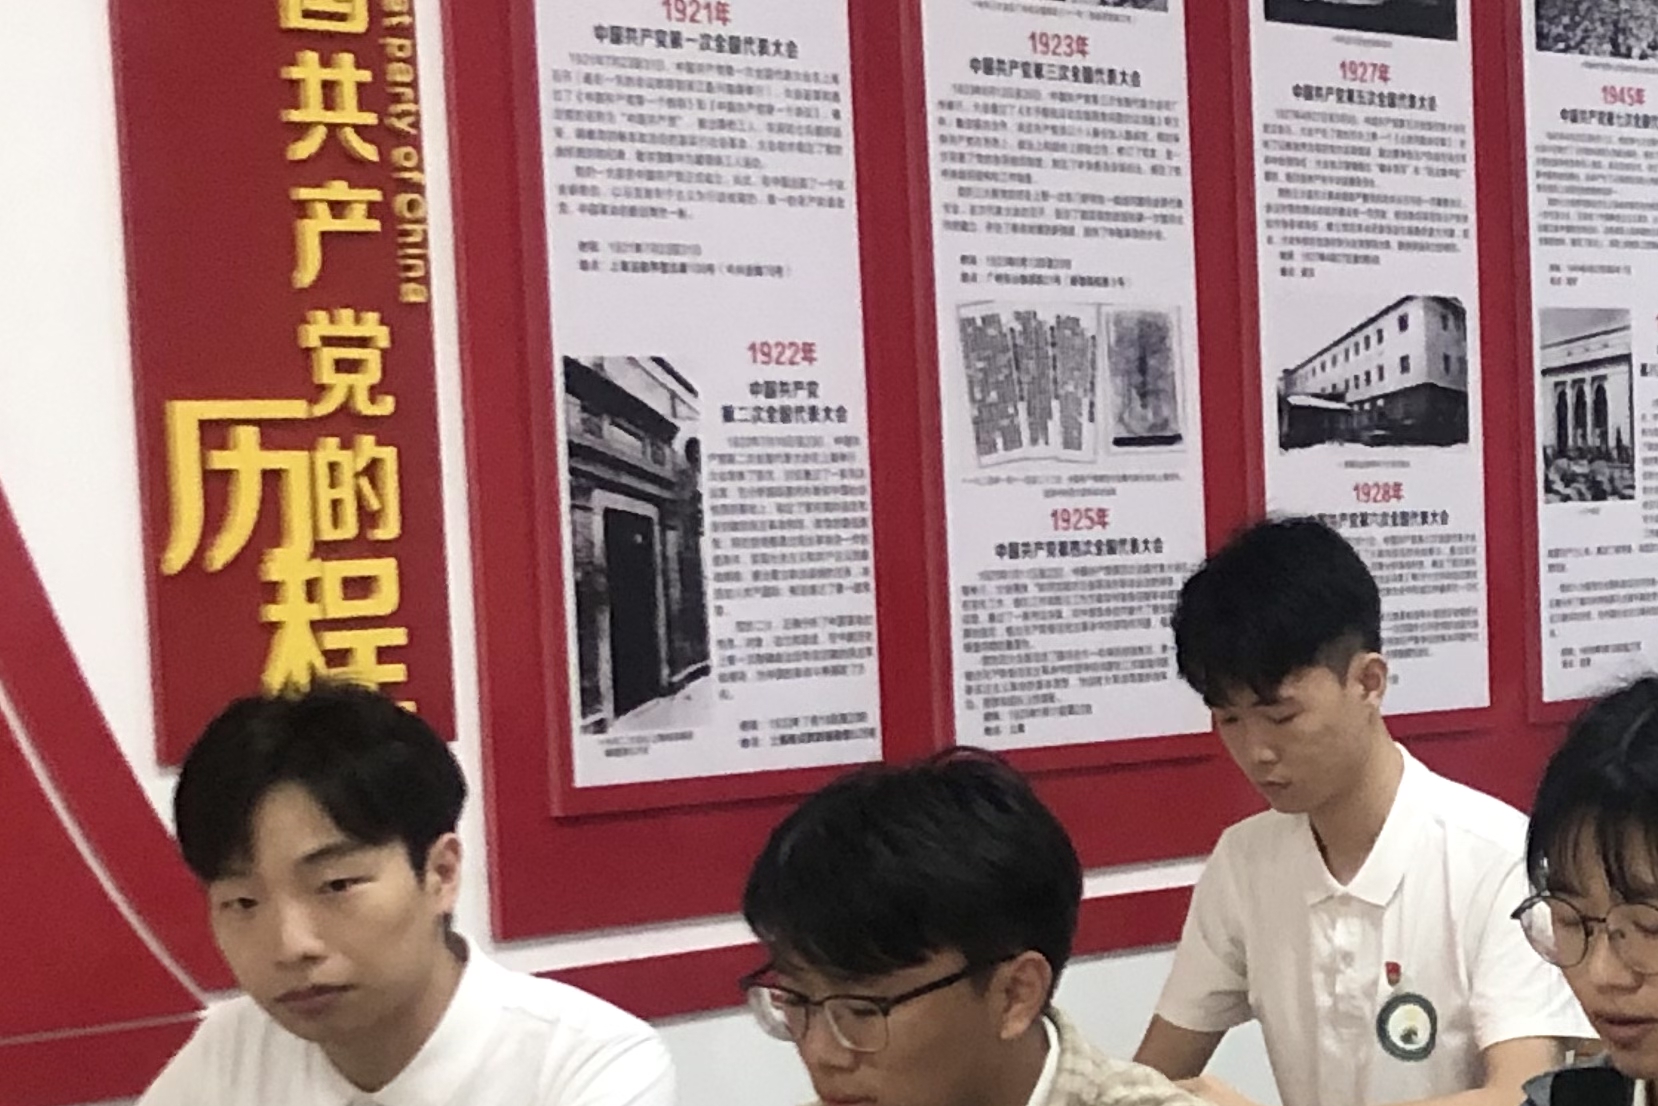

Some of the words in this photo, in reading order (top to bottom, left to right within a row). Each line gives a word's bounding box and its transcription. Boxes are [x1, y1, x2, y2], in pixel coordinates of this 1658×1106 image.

[661, 0, 732, 26] 1921年
[593, 24, 799, 59] 中国共产党第一次全国代表大会
[1027, 31, 1090, 58] 1923年
[969, 57, 1142, 87] 中国共产党第三次全国代表大会
[1339, 59, 1391, 83] 1927年
[379, 37, 419, 134] party
[1601, 85, 1647, 106] 1945年
[390, 145, 426, 187] of
[747, 341, 818, 366] 1922年
[749, 380, 820, 399] 中国共产党
[1353, 481, 1406, 503] 1928年
[1050, 507, 1110, 531] 1925年
